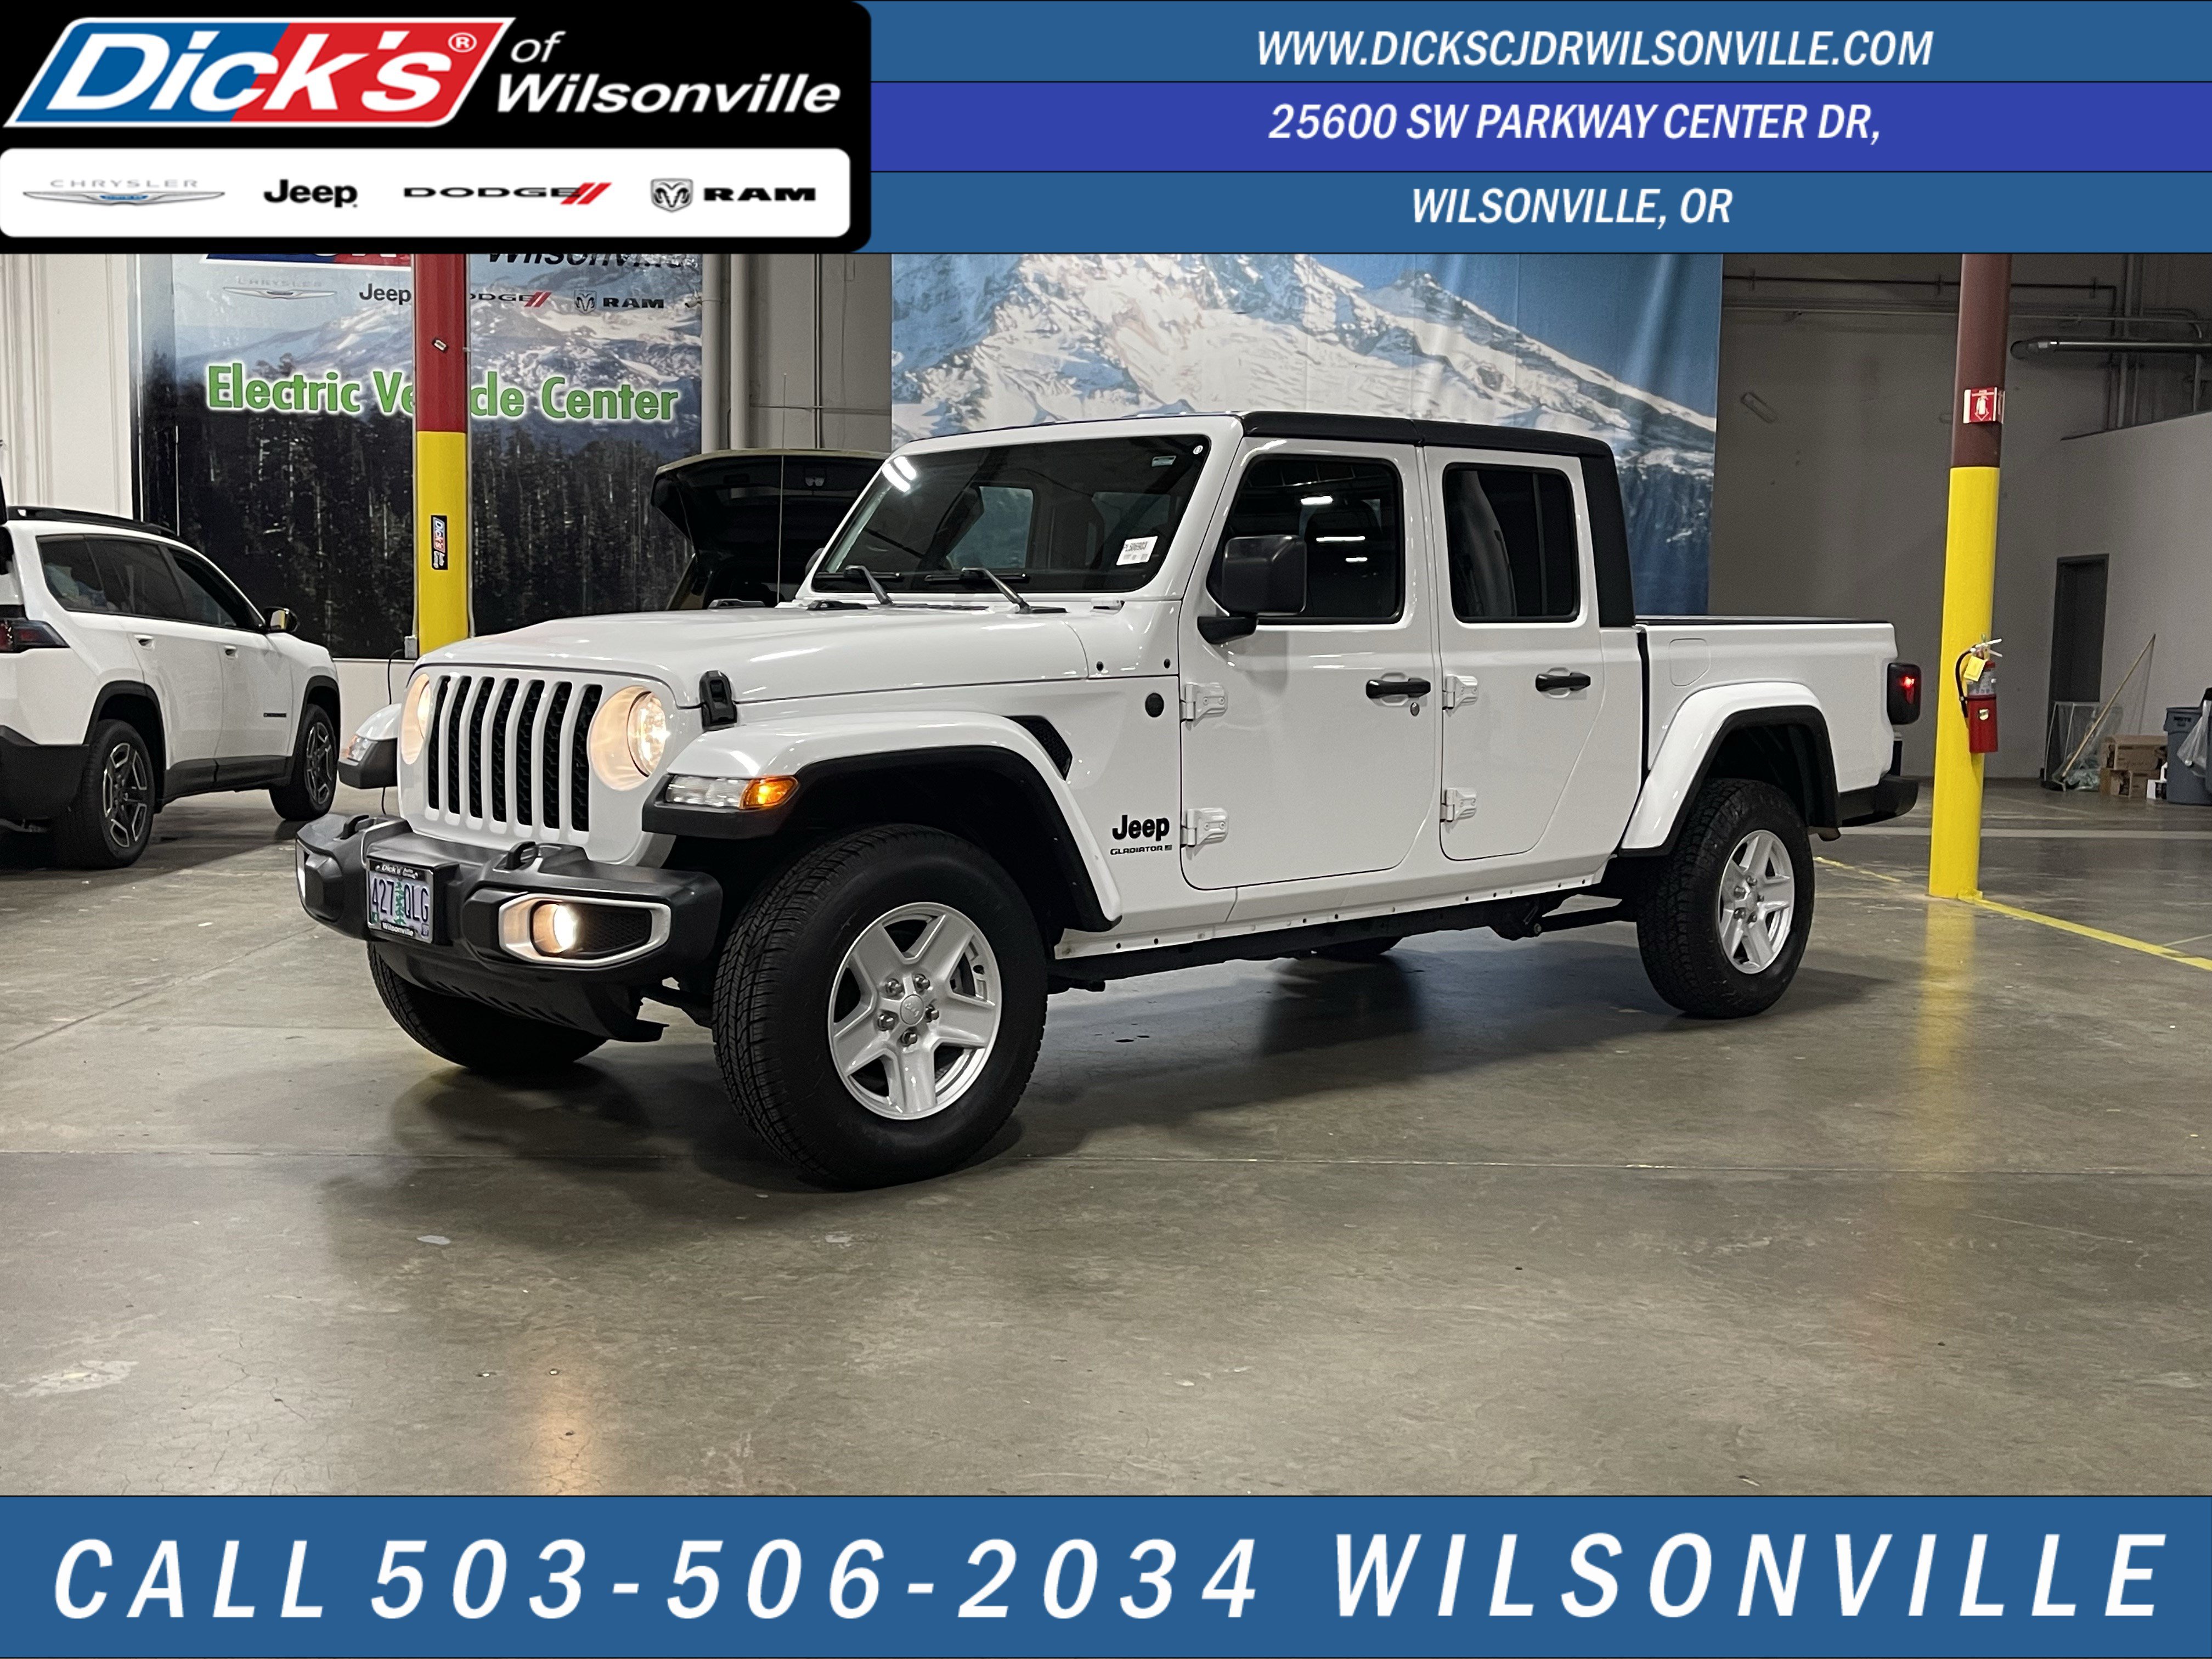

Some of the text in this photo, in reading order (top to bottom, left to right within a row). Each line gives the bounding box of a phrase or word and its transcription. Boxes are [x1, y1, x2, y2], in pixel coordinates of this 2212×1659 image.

[359, 283, 411, 305] Jeep
[470, 294, 535, 302] DGE
[603, 297, 664, 308] RAM
[208, 363, 679, 420] Electric Vcle Center
[1111, 814, 1170, 841] Jeep
[1110, 845, 1163, 855] GLADIATOR
[372, 878, 429, 922] 427 QLG
